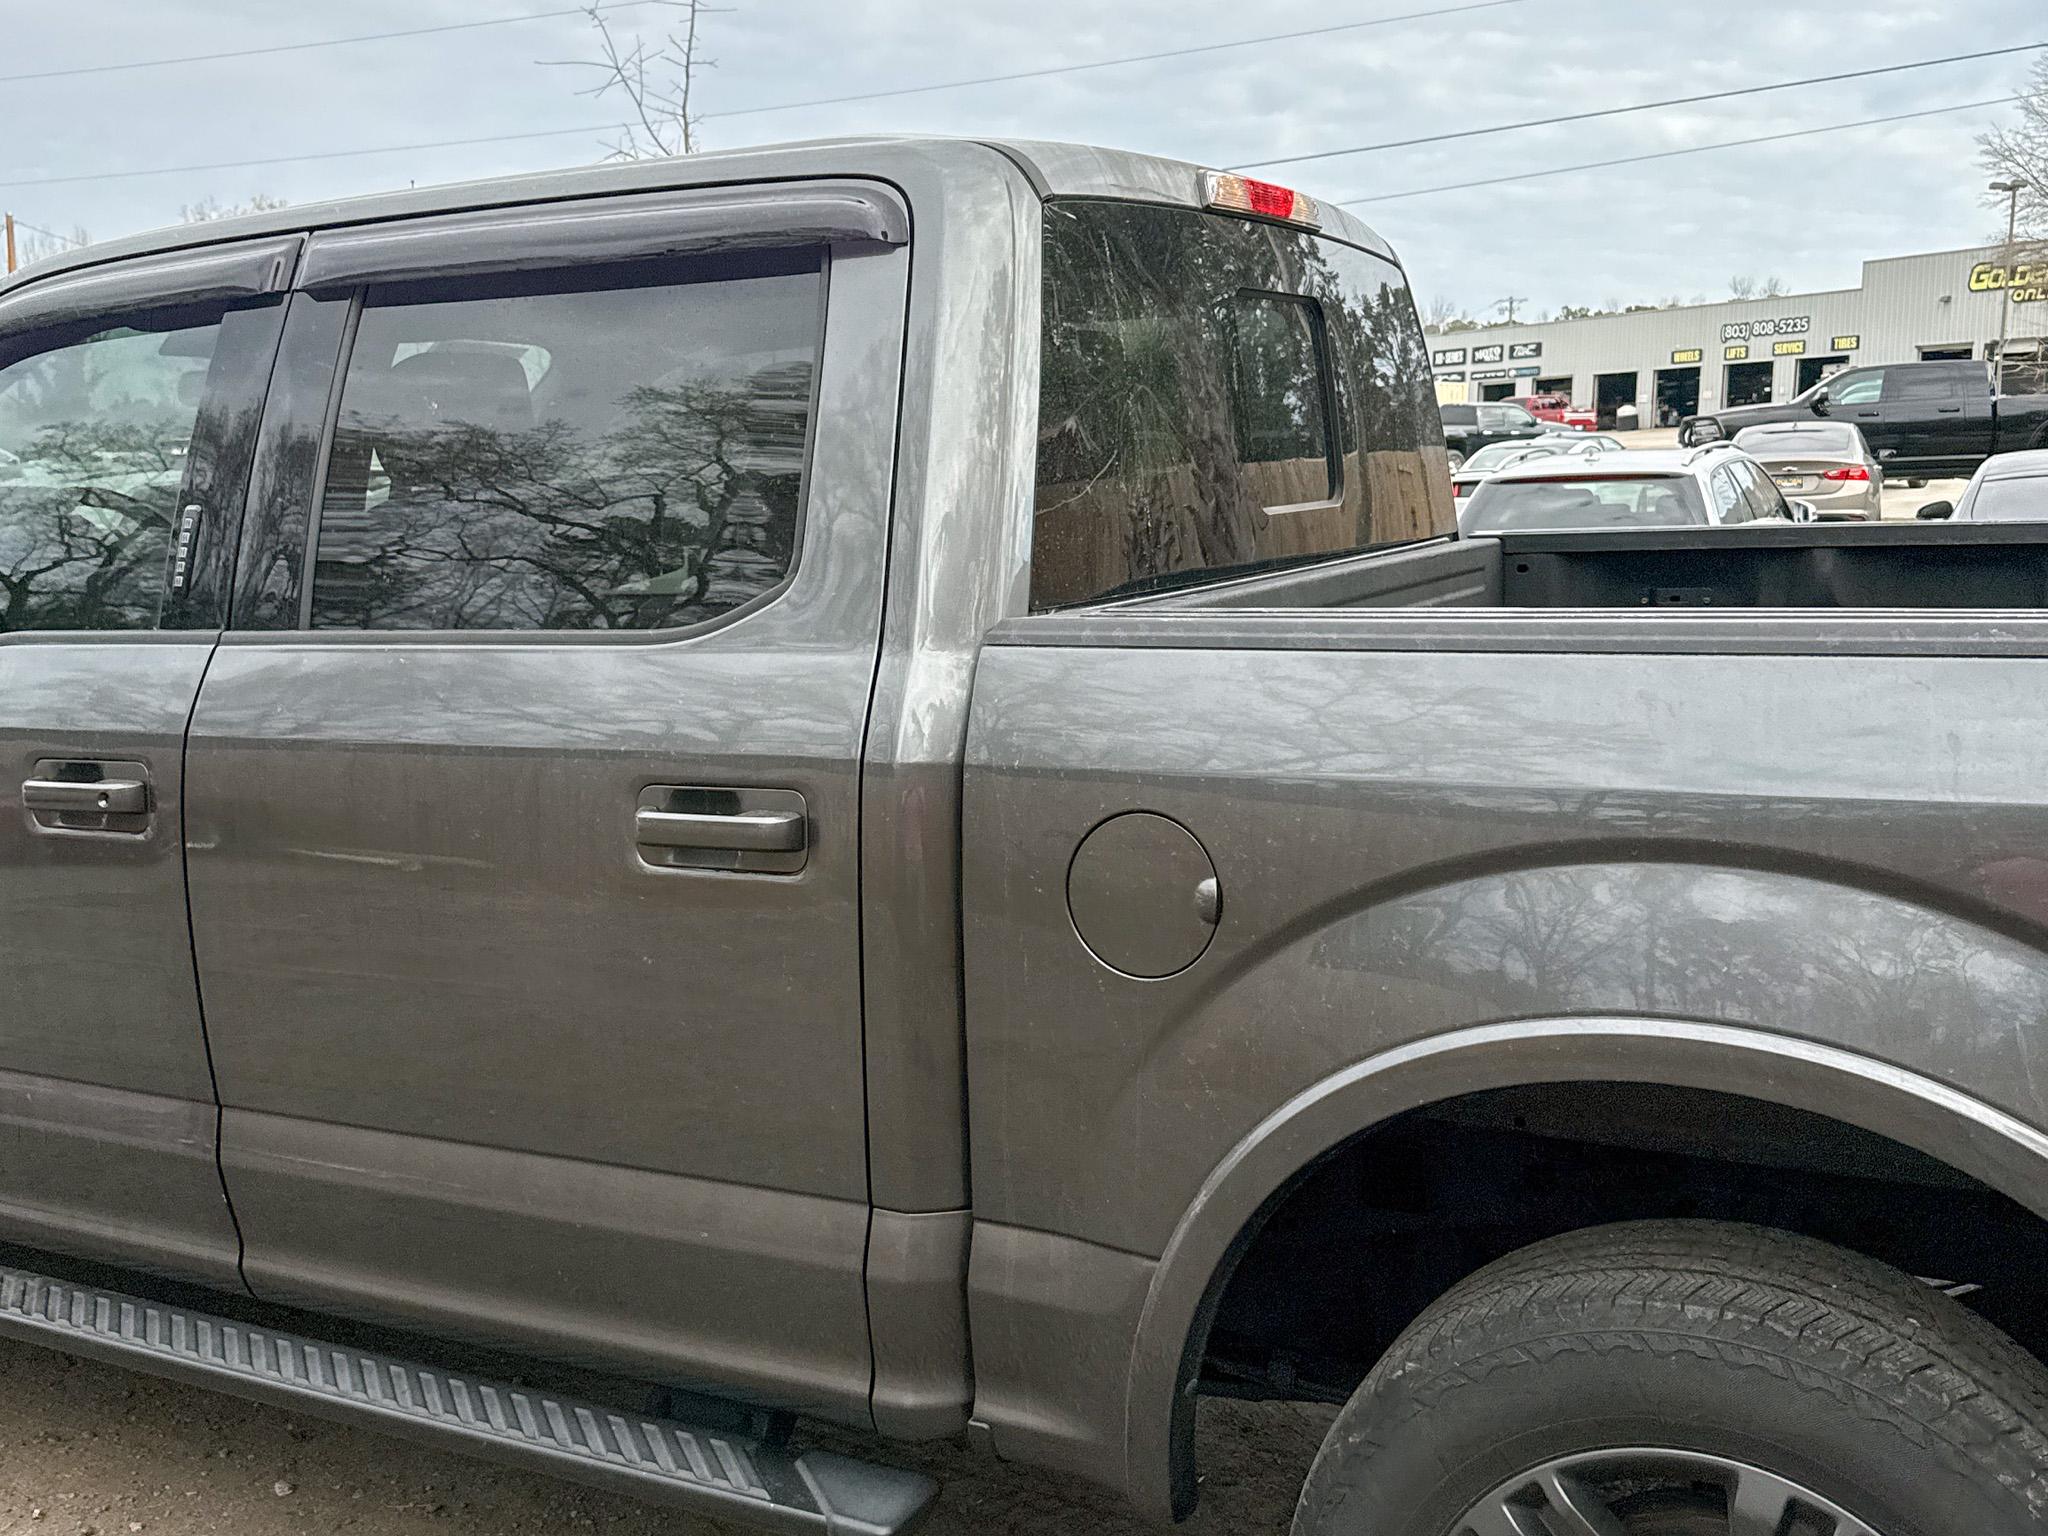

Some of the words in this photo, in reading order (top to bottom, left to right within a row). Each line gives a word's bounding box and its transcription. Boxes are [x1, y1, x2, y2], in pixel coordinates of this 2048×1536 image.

[1721, 324, 1750, 342] (803)
[1752, 317, 1809, 336] 808-5235
[1773, 341, 1805, 355] SERVICE
[1833, 336, 1858, 350] TIRES
[1673, 350, 1700, 363] WHEELS
[1725, 346, 1746, 360] LIFTS
